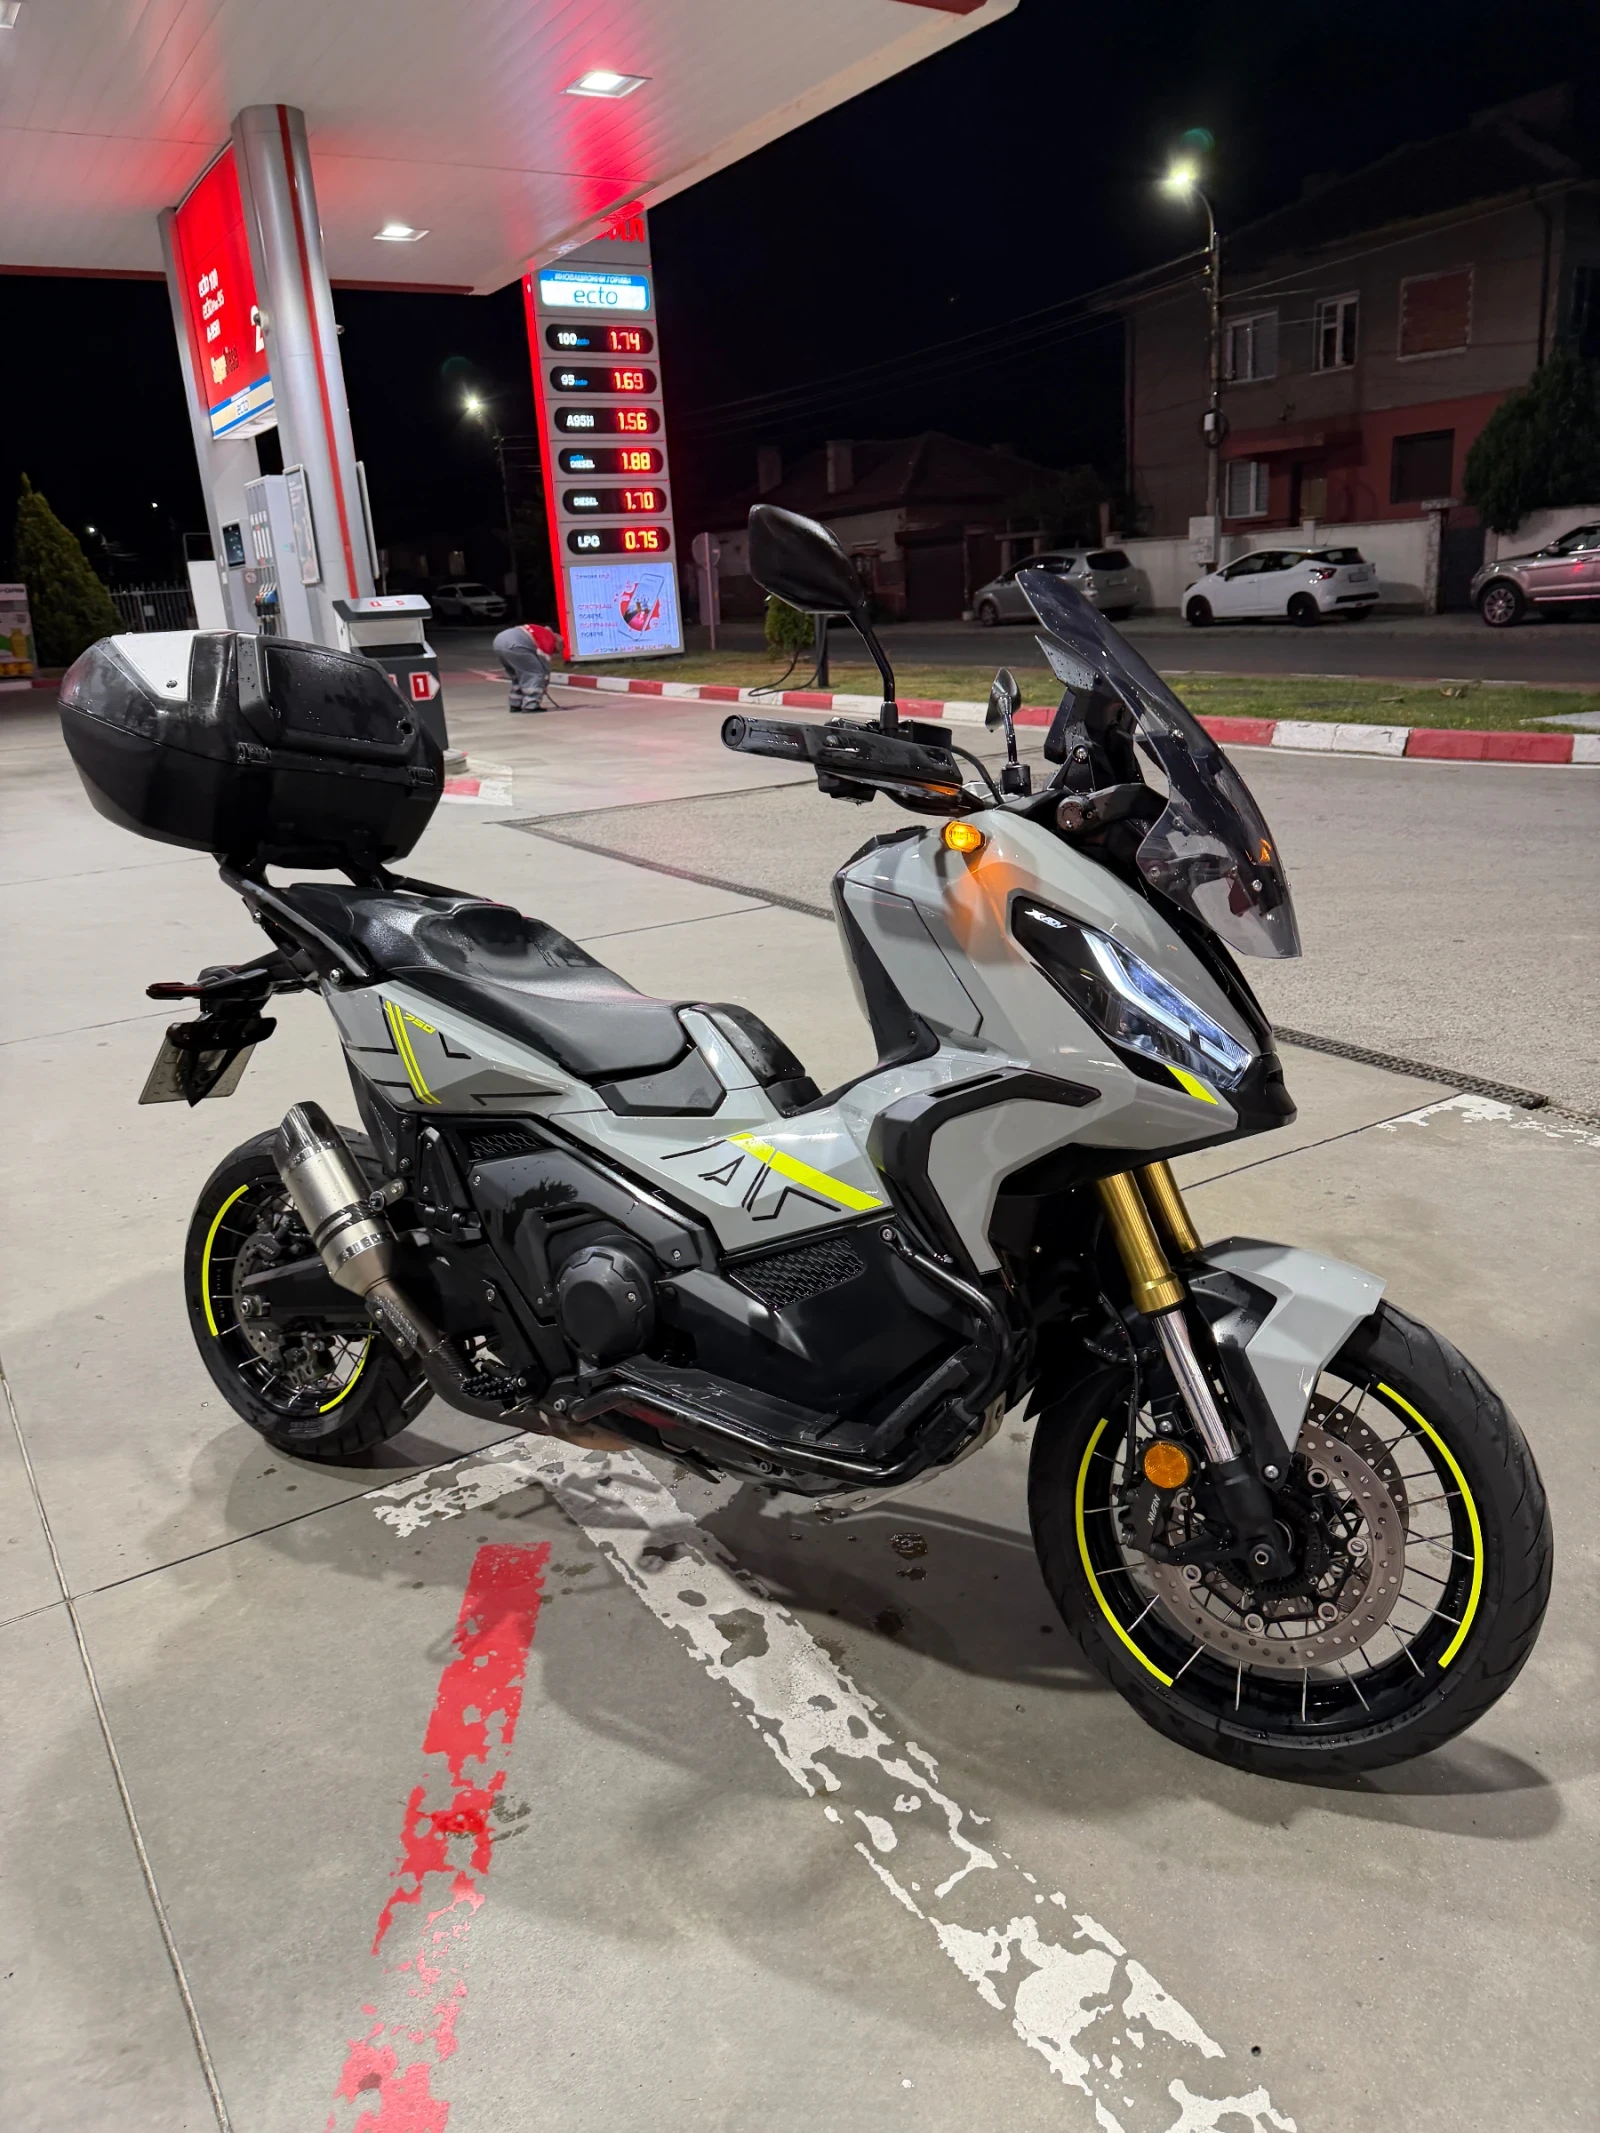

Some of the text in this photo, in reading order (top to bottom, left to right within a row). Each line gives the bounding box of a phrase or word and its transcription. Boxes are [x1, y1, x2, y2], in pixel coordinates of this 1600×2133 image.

[573, 286, 618, 305] ecto
[610, 331, 641, 351] 1.74
[614, 372, 645, 390] 1.69
[618, 411, 648, 431] 1.56
[621, 452, 651, 470] 1.88
[625, 491, 655, 510] 1.70
[577, 531, 658, 549] LPG 0.75
[403, 1012, 436, 1034] 750
